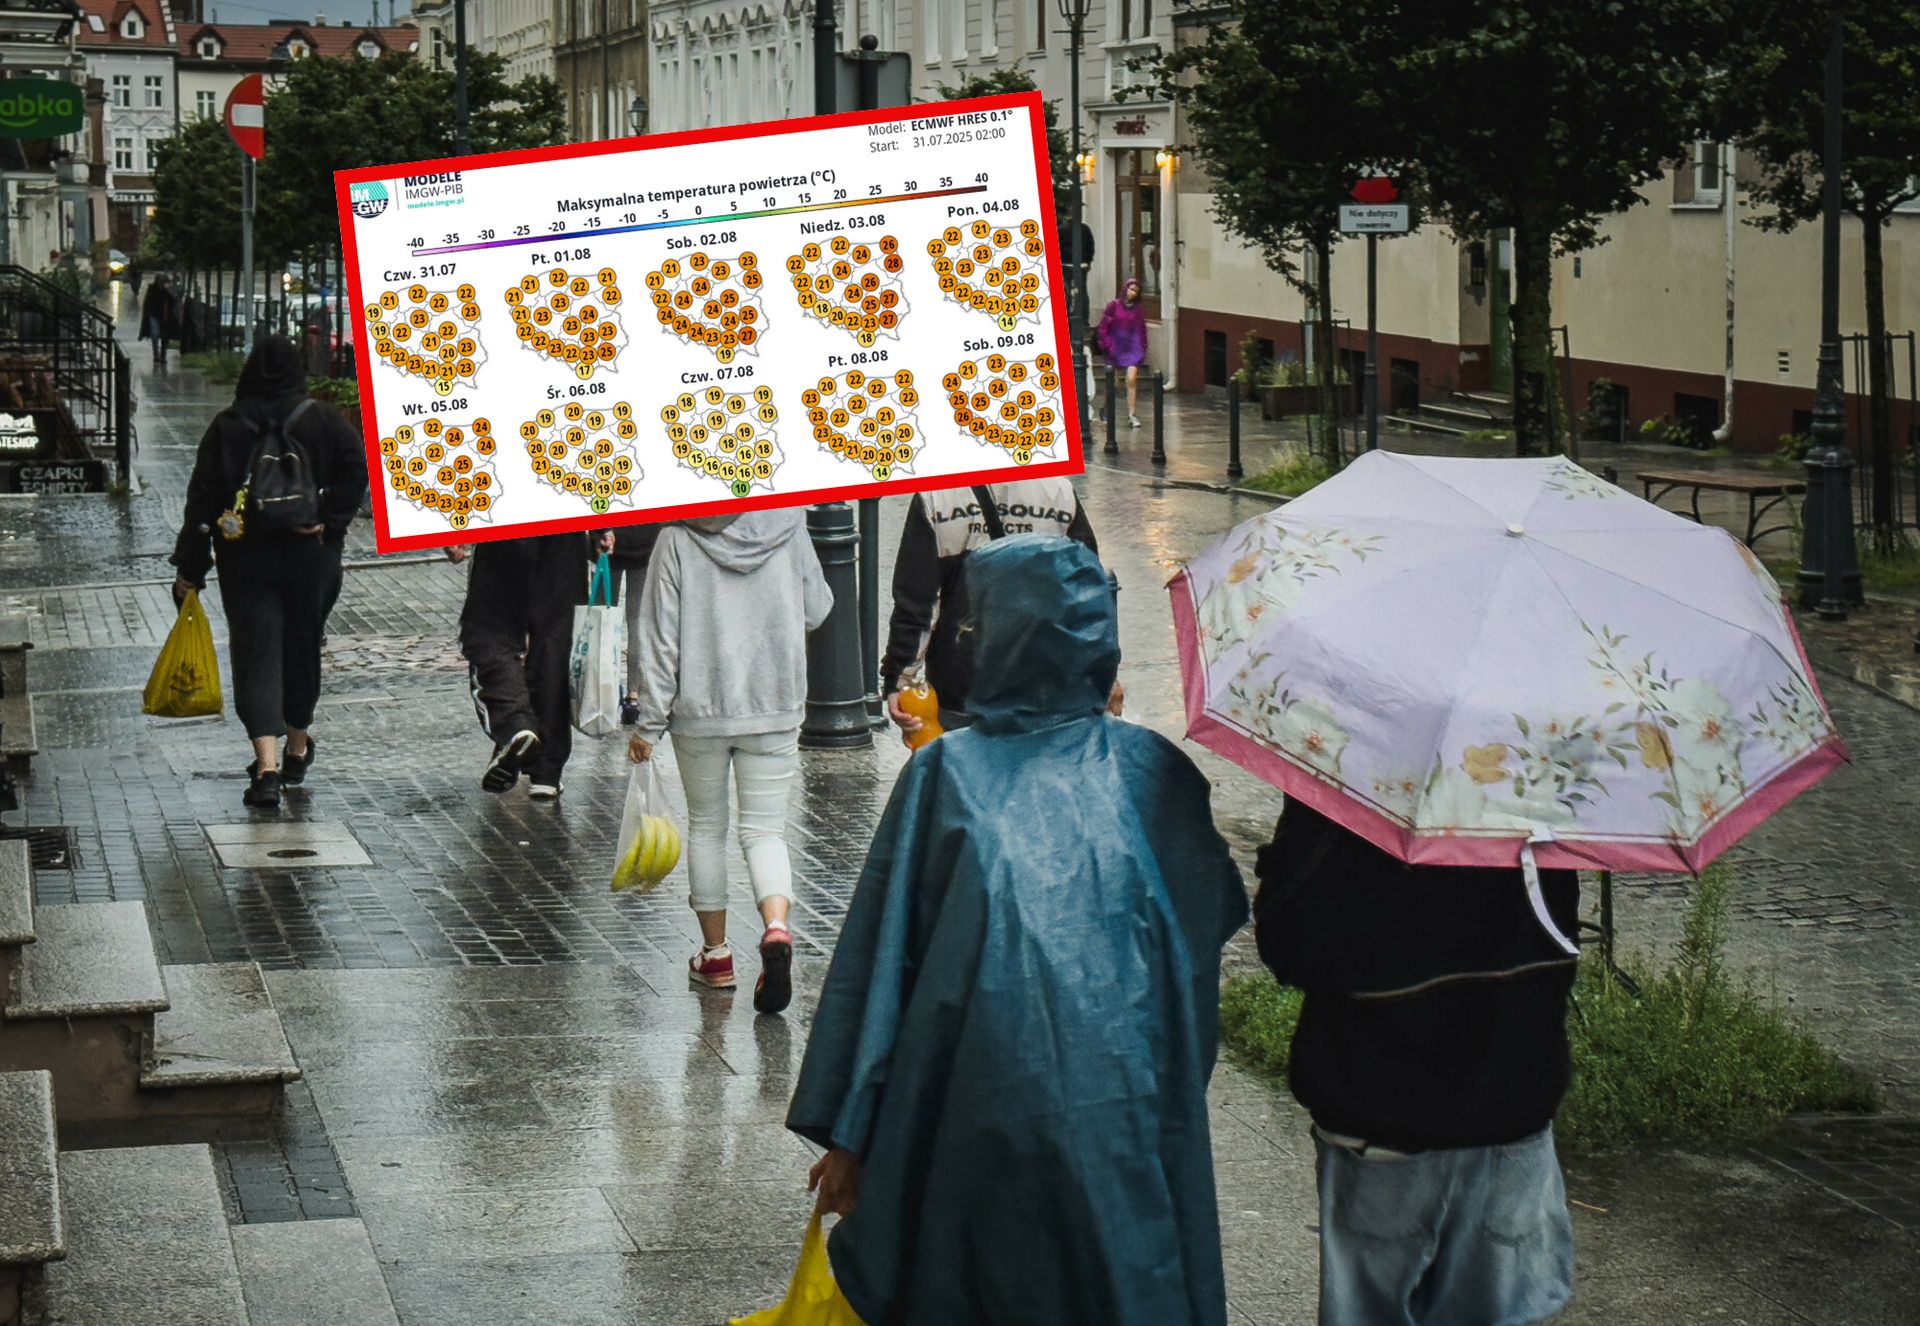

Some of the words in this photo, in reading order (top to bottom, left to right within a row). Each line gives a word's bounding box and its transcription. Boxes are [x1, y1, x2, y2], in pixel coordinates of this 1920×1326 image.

[0, 93, 73, 116] abka
[20, 466, 84, 480] CZAPKI
[932, 503, 982, 523] LAC
[997, 503, 1073, 523] SQUAD
